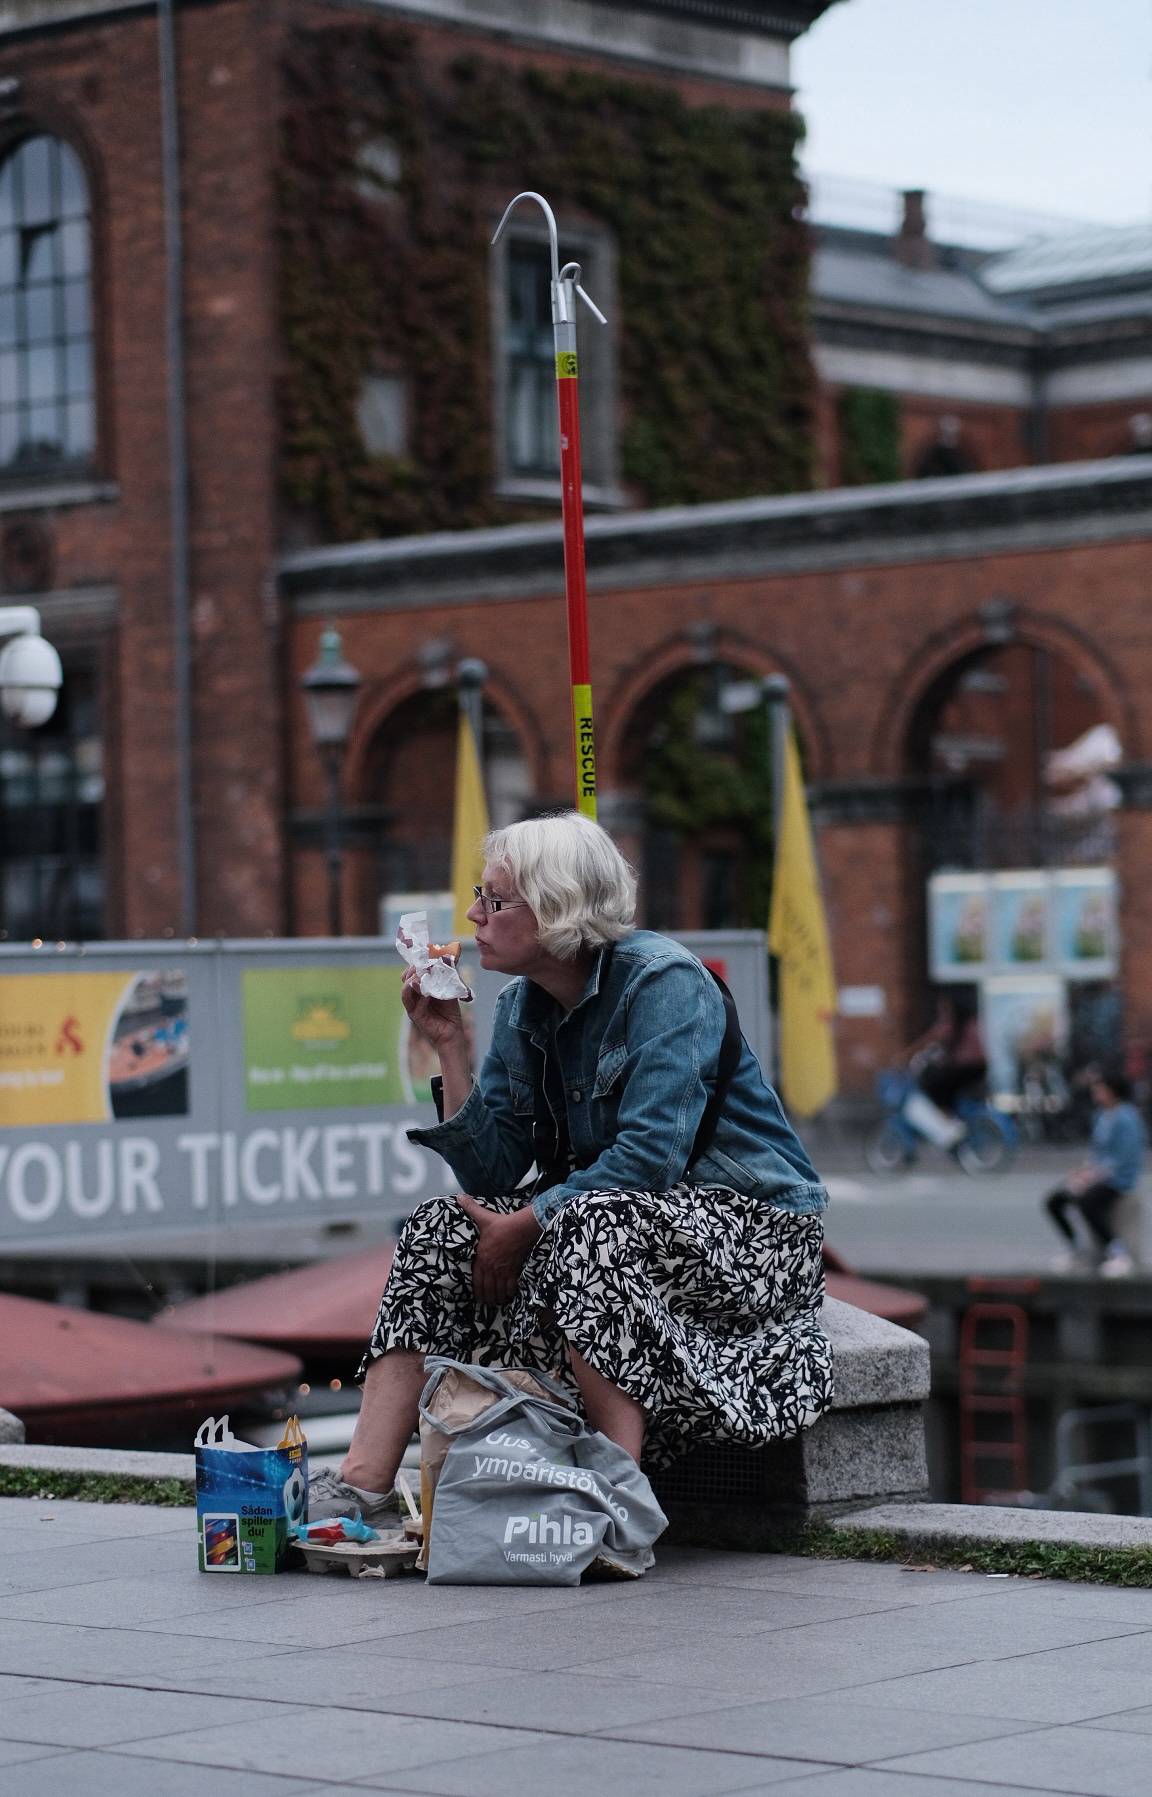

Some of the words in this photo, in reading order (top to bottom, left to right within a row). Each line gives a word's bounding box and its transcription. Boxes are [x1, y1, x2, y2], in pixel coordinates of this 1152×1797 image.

[578, 717, 596, 797] RESCUE
[179, 1120, 426, 1208] TICKETS
[241, 1505, 273, 1515] Sådan
[241, 1516, 273, 1527] spiller
[247, 1528, 265, 1537] du!
[503, 1513, 594, 1546] Pihla
[503, 1551, 547, 1562] Varmasti
[549, 1552, 576, 1565] hyvä.
